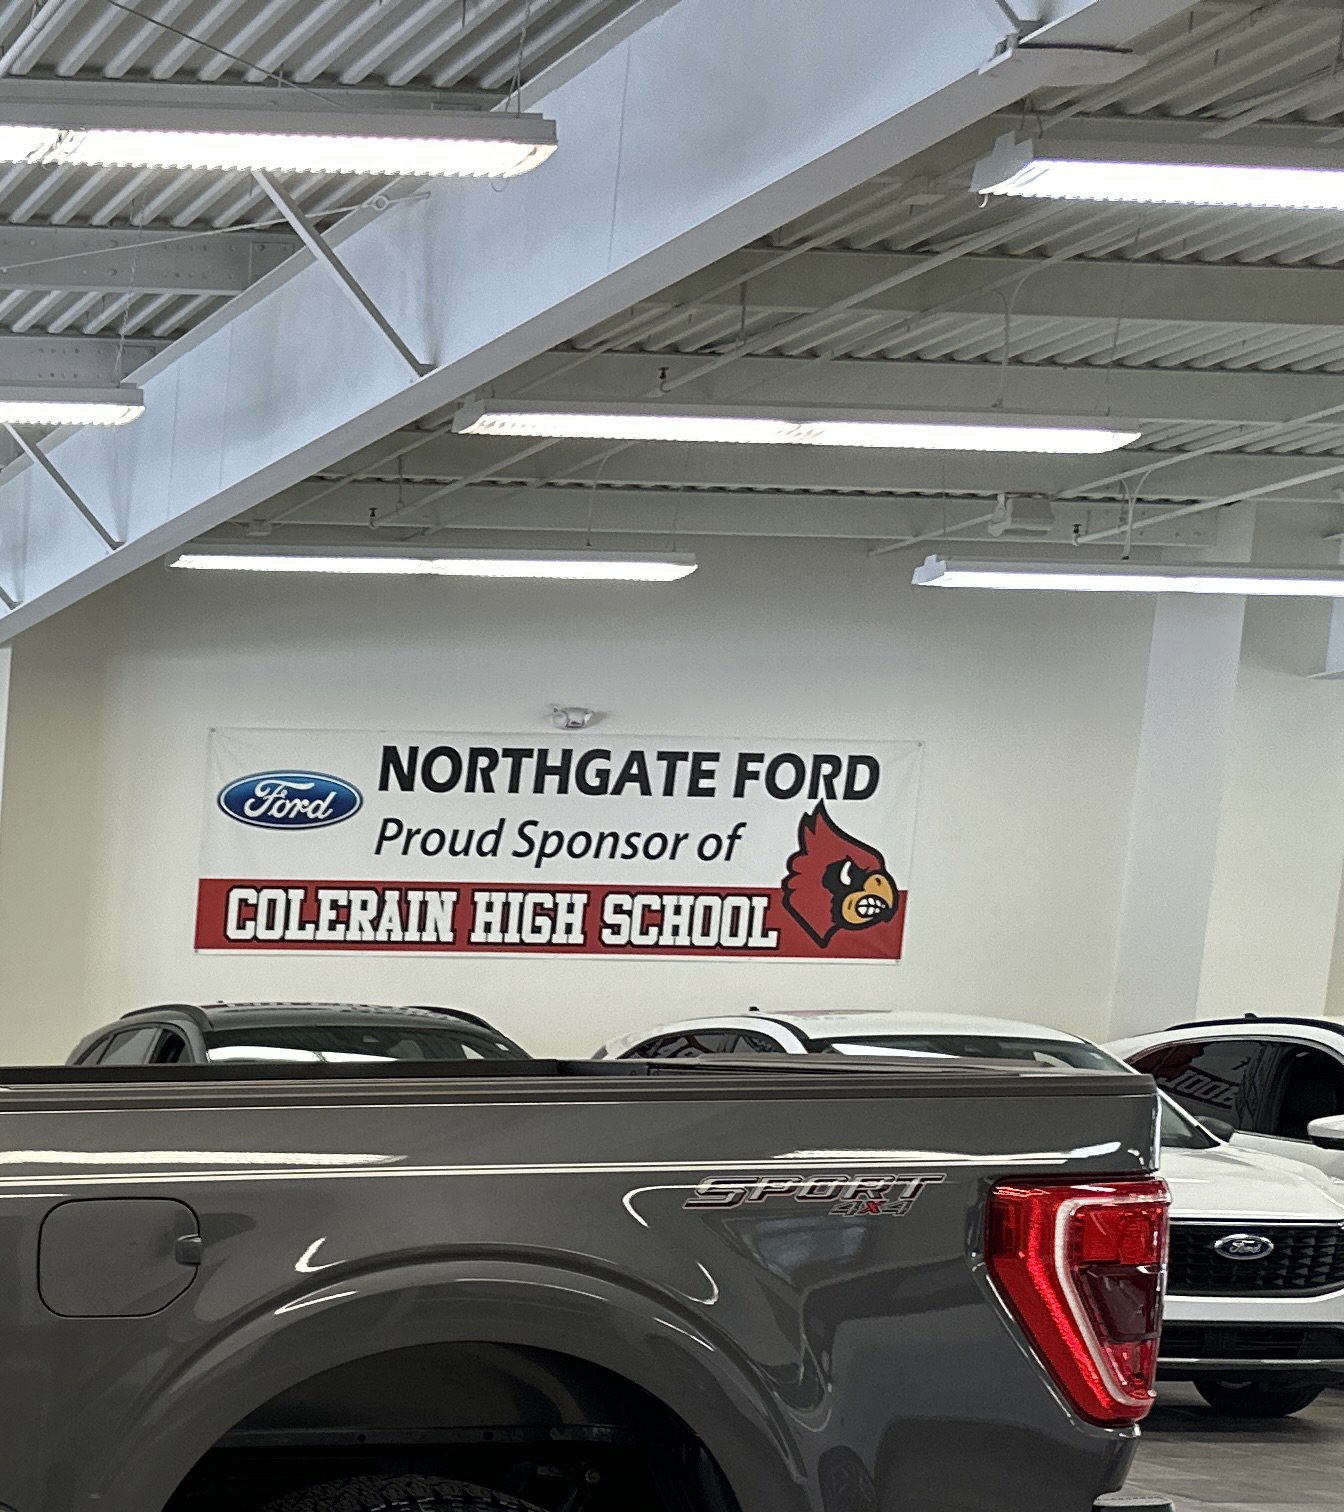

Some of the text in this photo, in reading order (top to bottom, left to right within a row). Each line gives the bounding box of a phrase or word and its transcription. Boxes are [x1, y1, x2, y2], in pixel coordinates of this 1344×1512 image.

[243, 779, 334, 819] Ford
[378, 745, 880, 801] NORTHGATE FORD
[374, 817, 747, 869] Proud Sponsor of
[225, 886, 779, 948] COLERAIN HIGH SCHOOL
[683, 1173, 948, 1210] SPORT
